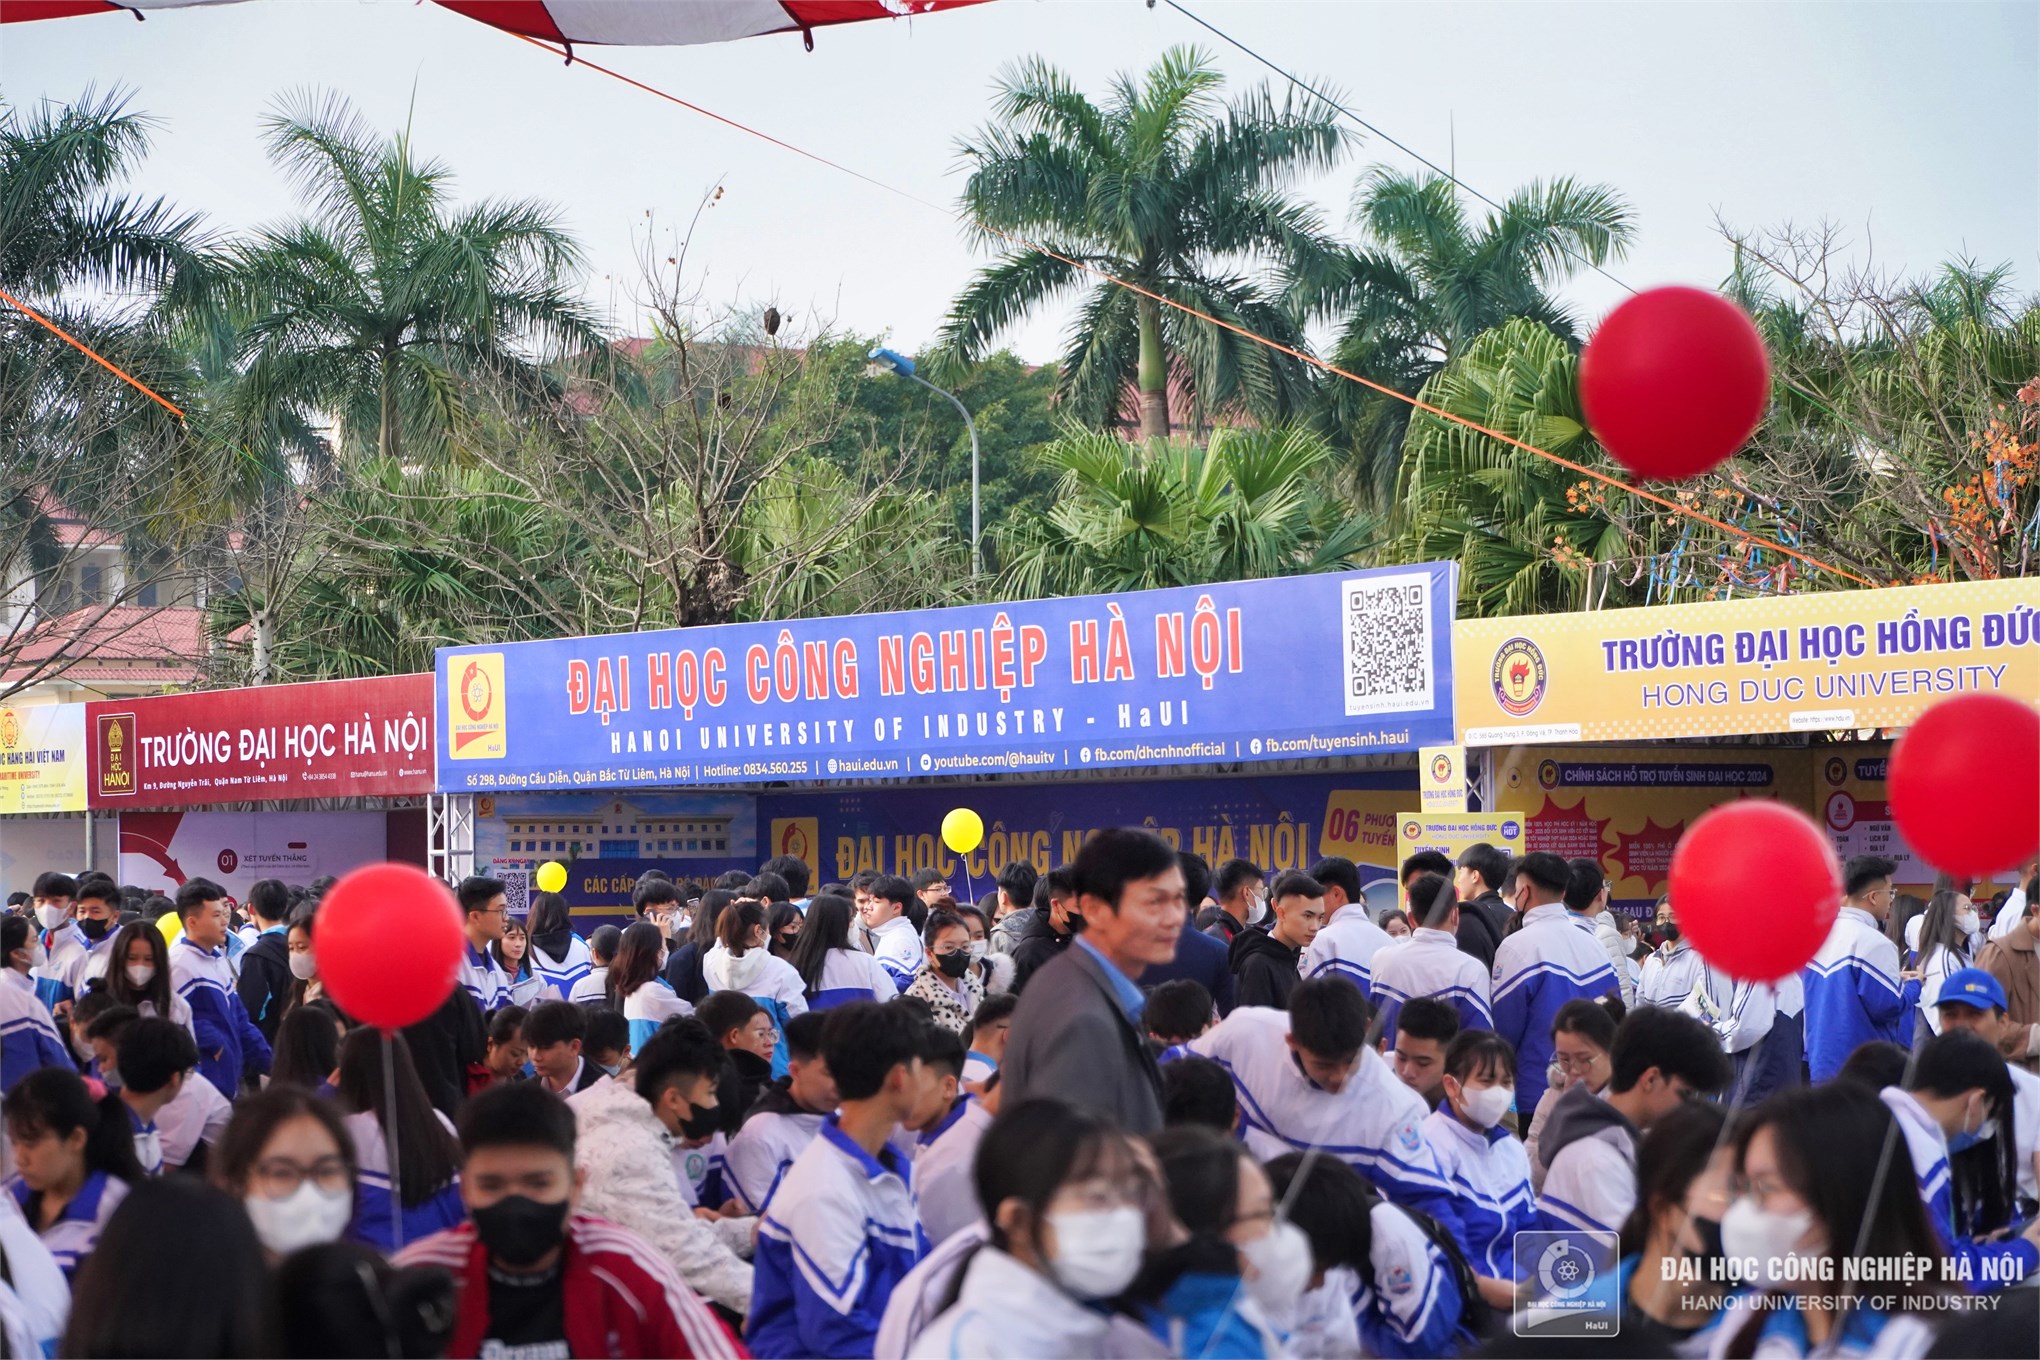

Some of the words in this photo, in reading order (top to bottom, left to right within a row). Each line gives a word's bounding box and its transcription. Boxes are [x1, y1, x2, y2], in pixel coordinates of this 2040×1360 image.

[1601, 628, 1725, 672] TRƯỜNG
[1735, 627, 1788, 670] ĐẠI
[1800, 624, 1865, 666] HỌC
[1877, 609, 1971, 655] HỒNG
[566, 655, 630, 726] ĐẠI
[647, 646, 727, 721] HỌC
[745, 628, 859, 705] CÔNG
[878, 612, 1047, 703] NGHIỆP
[1070, 602, 1135, 685] HÀ
[1156, 594, 1242, 690] NỘI
[1642, 681, 1728, 708] HONG
[1740, 676, 1804, 702] DUC
[1816, 664, 2008, 699] UNIVERSITY
[1349, 698, 1430, 712] tuyensinh.haui.edu.vn
[140, 726, 232, 769] TRƯỜNG
[238, 727, 276, 769] ĐẠI
[284, 723, 336, 766] HỌC
[344, 712, 377, 756] HÀ
[384, 710, 427, 761] NỘI
[611, 728, 681, 754] HANOI
[699, 720, 854, 750] UNIVERSITY
[874, 716, 903, 741] OF
[923, 707, 1064, 739] INDUSTRY
[1118, 700, 1188, 729] HaUI
[110, 753, 122, 762] ĐẠI
[466, 772, 478, 786] Số
[479, 774, 497, 787] 298,
[498, 772, 527, 787] Đường
[529, 770, 546, 785] Cầu
[548, 769, 571, 785] Diễn,
[573, 770, 596, 785] Quận
[600, 767, 616, 782] Bắc
[618, 769, 630, 781] Từ
[632, 767, 657, 781] Liêm,
[659, 766, 672, 779] Hà
[675, 765, 690, 780] Nội
[703, 764, 742, 778] Hotline:
[743, 760, 808, 775] 0834.560.255
[838, 758, 898, 773] haui.edu.vn
[933, 748, 1055, 771] youtube.com/@hauitv
[1094, 741, 1226, 762] fb.com/dhcnhnofficial
[1265, 728, 1410, 753] fb.com/tuyensinh.haui
[1565, 767, 1594, 782] CHÍNH
[1596, 767, 1622, 782] SÁCH
[1623, 765, 1637, 782] HỖ
[1639, 769, 1656, 784] TRỢ
[1658, 765, 1684, 782] TUYỂN
[1686, 770, 1706, 782] SINH
[1707, 770, 1723, 784] ĐẠI
[1725, 770, 1745, 784] HỌC
[1747, 770, 1767, 782] 2024
[153, 782, 158, 791] 9,
[159, 781, 176, 791] Đường
[177, 778, 197, 790] Nguyễn
[199, 778, 212, 787] Trãi,
[214, 777, 229, 787] Quận
[230, 776, 242, 784] Nam
[243, 775, 251, 784] Từ
[252, 775, 267, 784] Liêm,
[269, 774, 277, 782] Hà
[278, 773, 288, 783] Nội
[1328, 807, 1360, 843] 06
[221, 855, 234, 866] 01
[584, 875, 608, 894] CÁC
[611, 872, 635, 894] CẤP
